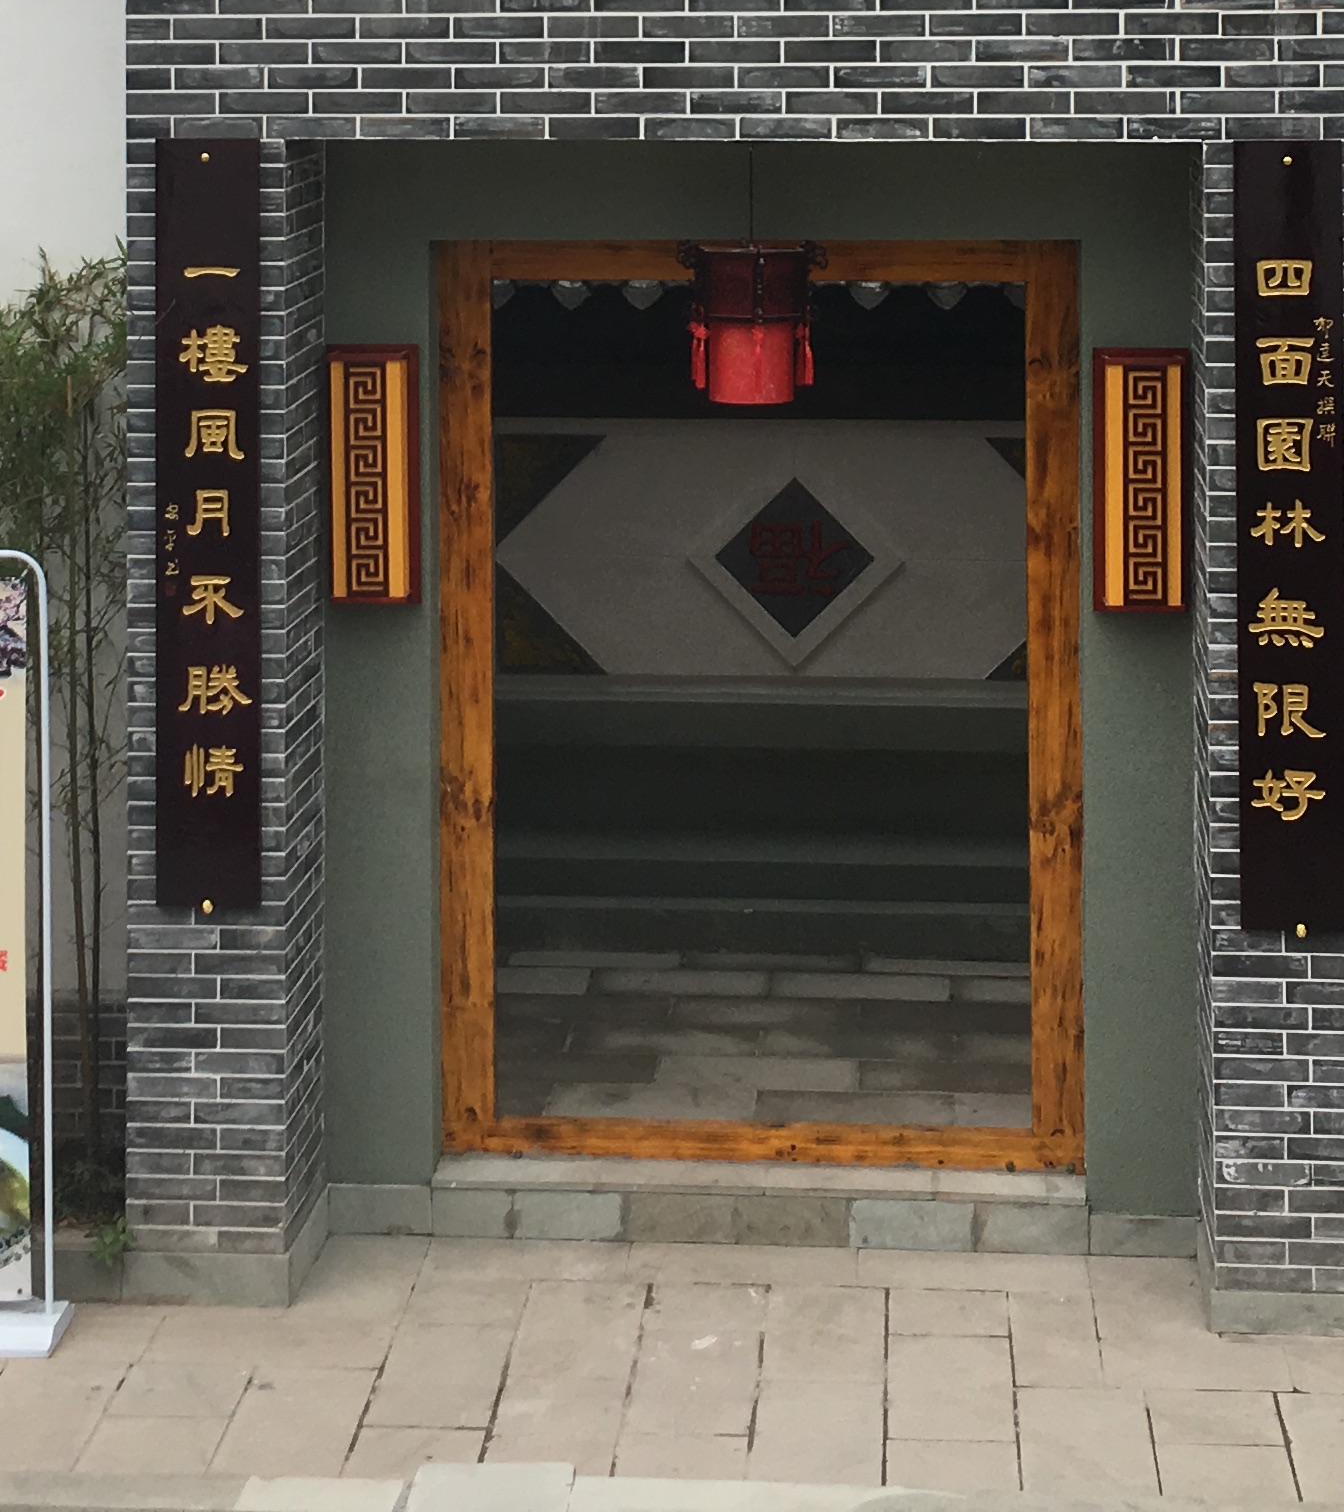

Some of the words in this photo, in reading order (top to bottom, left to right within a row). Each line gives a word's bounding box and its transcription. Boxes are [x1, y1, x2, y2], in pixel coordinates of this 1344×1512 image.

[178, 266, 253, 799] 一樓風月不勝情
[1247, 258, 1327, 822] 四面園林無限好
